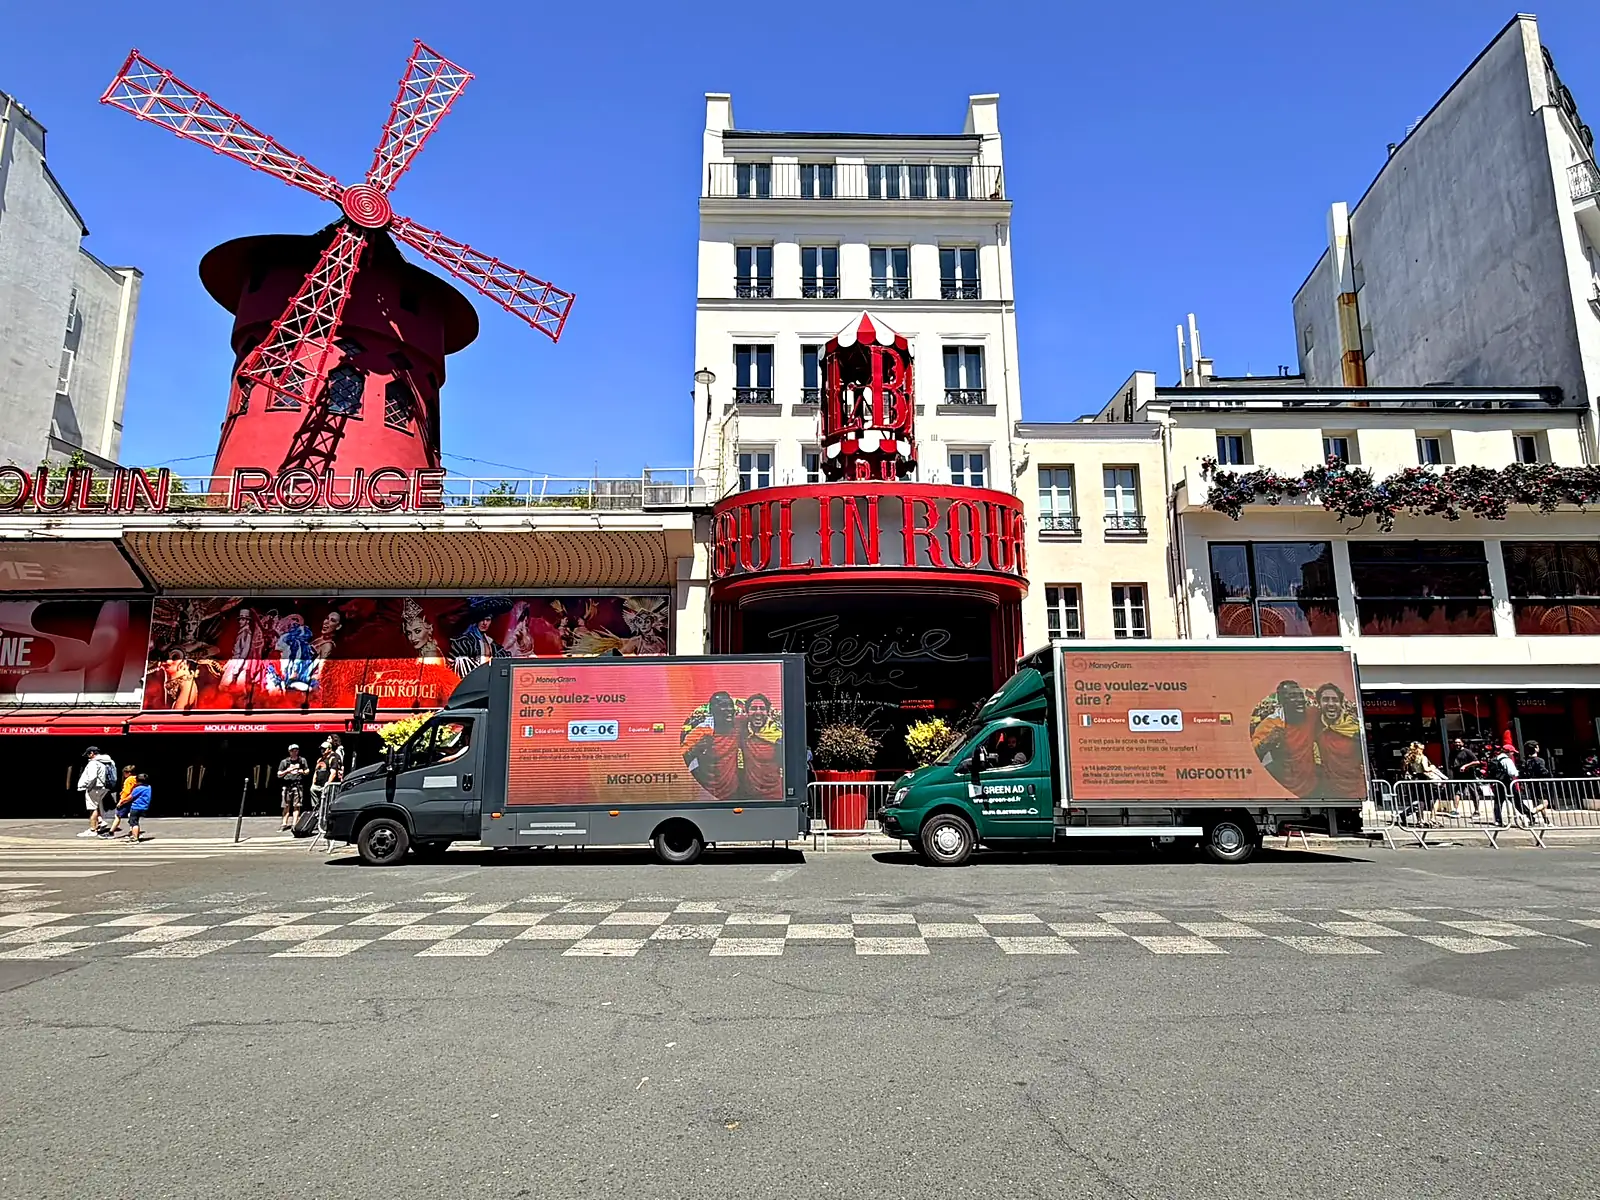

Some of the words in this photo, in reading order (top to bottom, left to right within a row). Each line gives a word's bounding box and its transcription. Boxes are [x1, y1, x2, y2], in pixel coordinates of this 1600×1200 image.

[231, 467, 446, 512] ROUGE
[0, 637, 34, 666] NE
[1088, 661, 1132, 670] MoneyGram
[370, 670, 421, 686] Forever
[536, 676, 576, 684] MoneyGram
[398, 684, 436, 698] ROUGE
[1074, 680, 1101, 692] Que
[1104, 680, 1188, 691] voulez-vous
[520, 693, 546, 704] Que
[549, 693, 626, 703] voulez-vous
[1075, 694, 1101, 705] dire
[1104, 694, 1112, 705] ?
[520, 706, 544, 717] dire
[546, 706, 554, 717] ?
[1132, 715, 1150, 725] 0€
[1161, 714, 1179, 725] 0€
[572, 725, 588, 735] 0€
[598, 725, 614, 735] 0€
[983, 785, 1011, 794] GREEN
[1012, 785, 1025, 794] AD
